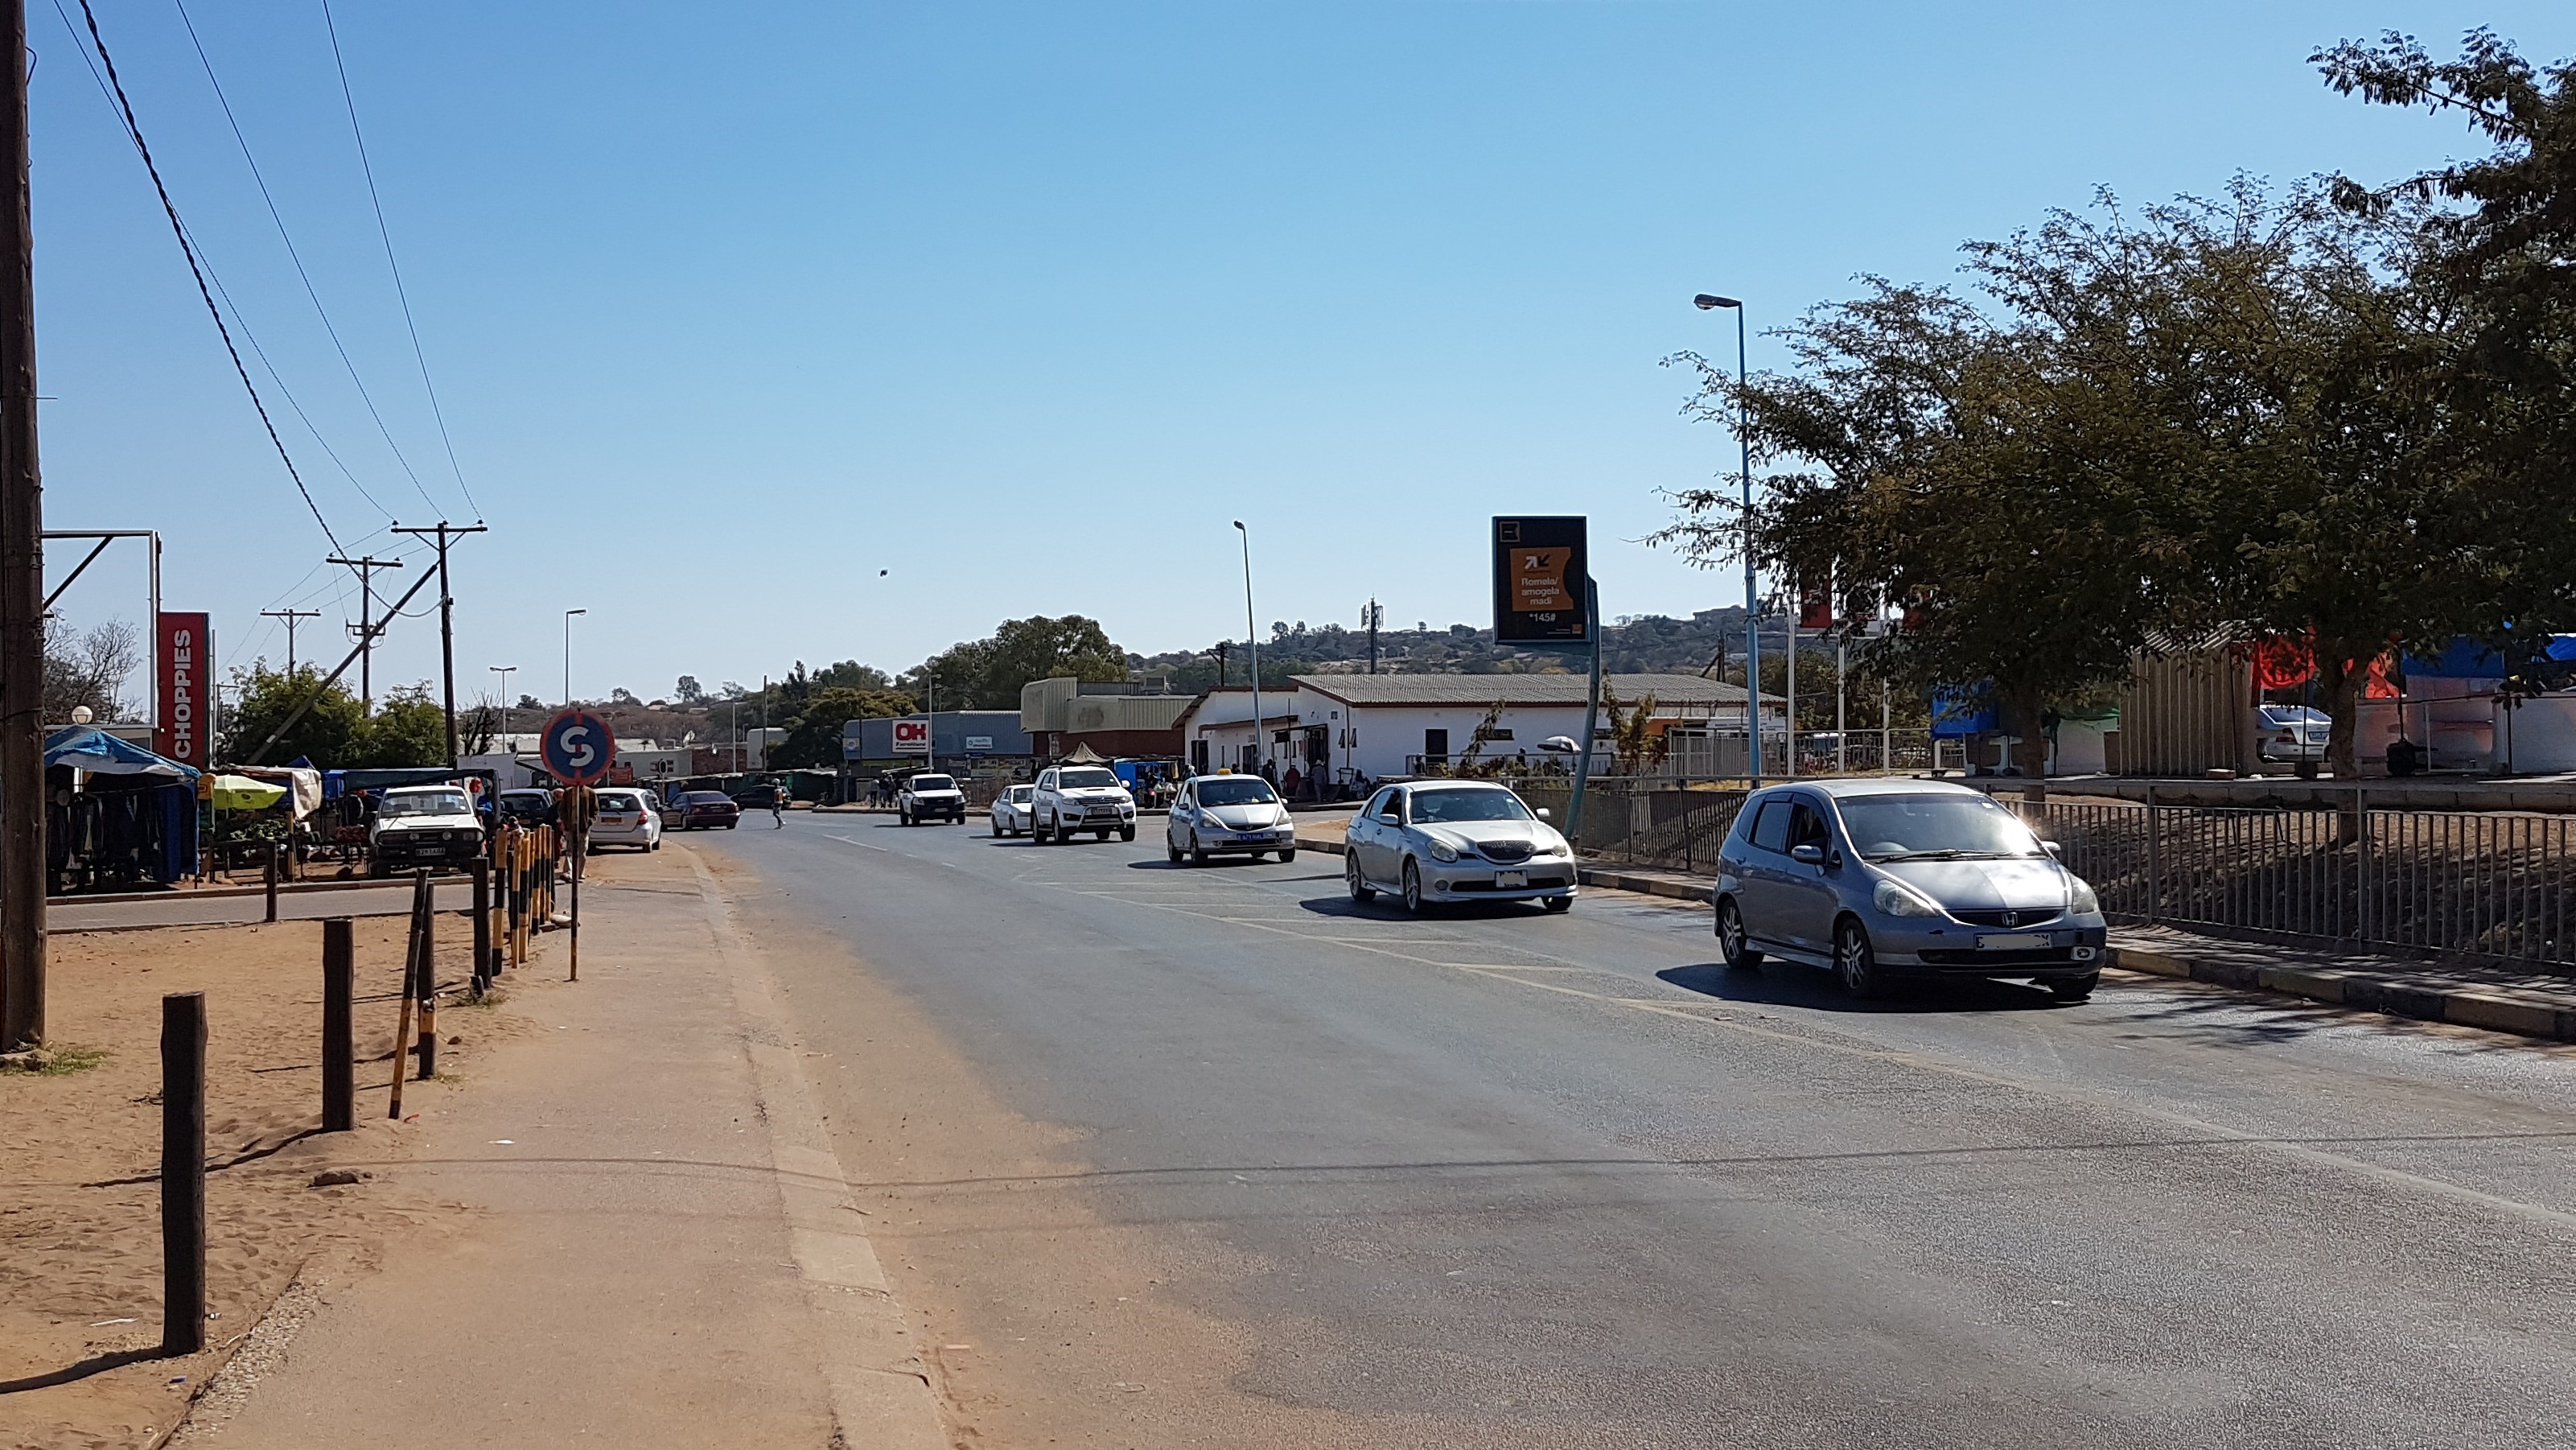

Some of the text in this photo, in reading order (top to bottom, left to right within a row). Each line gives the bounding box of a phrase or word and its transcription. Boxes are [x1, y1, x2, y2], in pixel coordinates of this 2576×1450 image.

[1521, 577, 1558, 586] Romela/
[1521, 587, 1560, 596] amogela
[1530, 597, 1552, 605] madi
[174, 629, 191, 759] CHOPPIES
[560, 726, 595, 767] S
